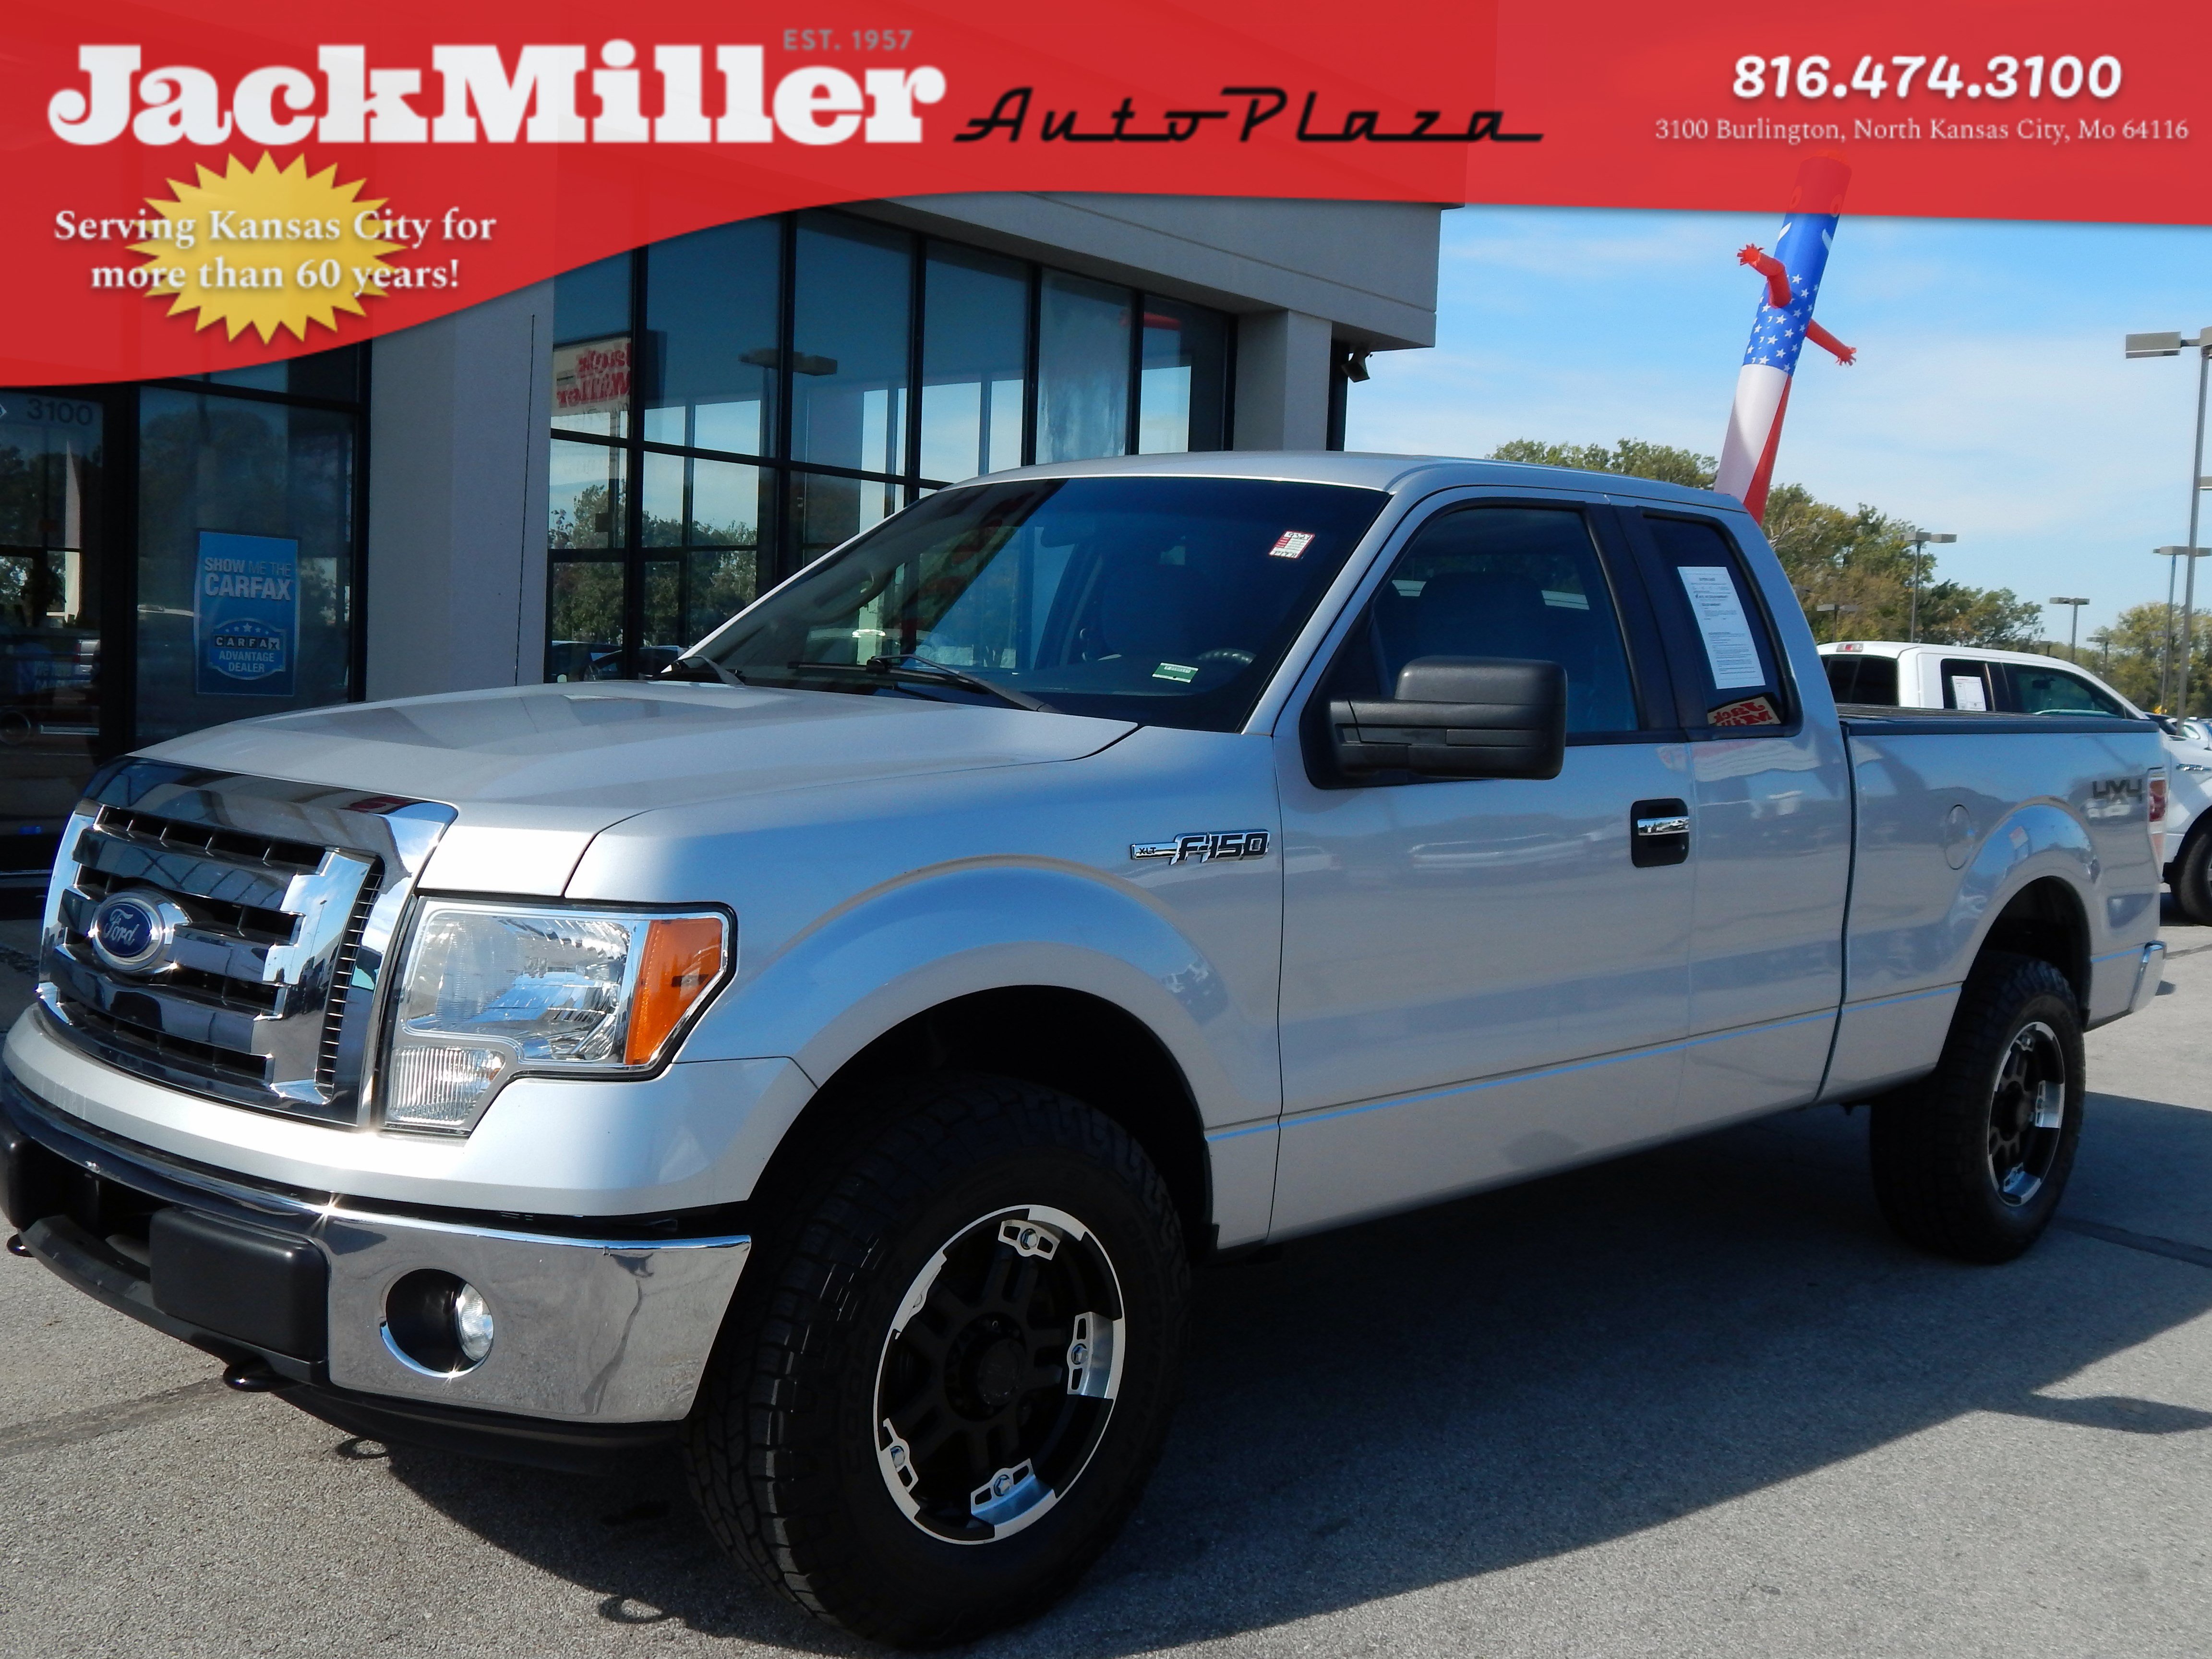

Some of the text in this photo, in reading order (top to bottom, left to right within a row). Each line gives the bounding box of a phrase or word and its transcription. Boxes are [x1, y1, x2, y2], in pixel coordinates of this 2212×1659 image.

[27, 398, 92, 425] 3100
[205, 557, 291, 577] SHOW ME THE
[205, 573, 291, 601] CARFAX
[216, 637, 280, 650] CARFAX
[219, 650, 275, 662] ADVANTAGE
[228, 662, 264, 672] DEALER
[1138, 847, 1156, 855] XLT
[104, 908, 140, 946] Ford
